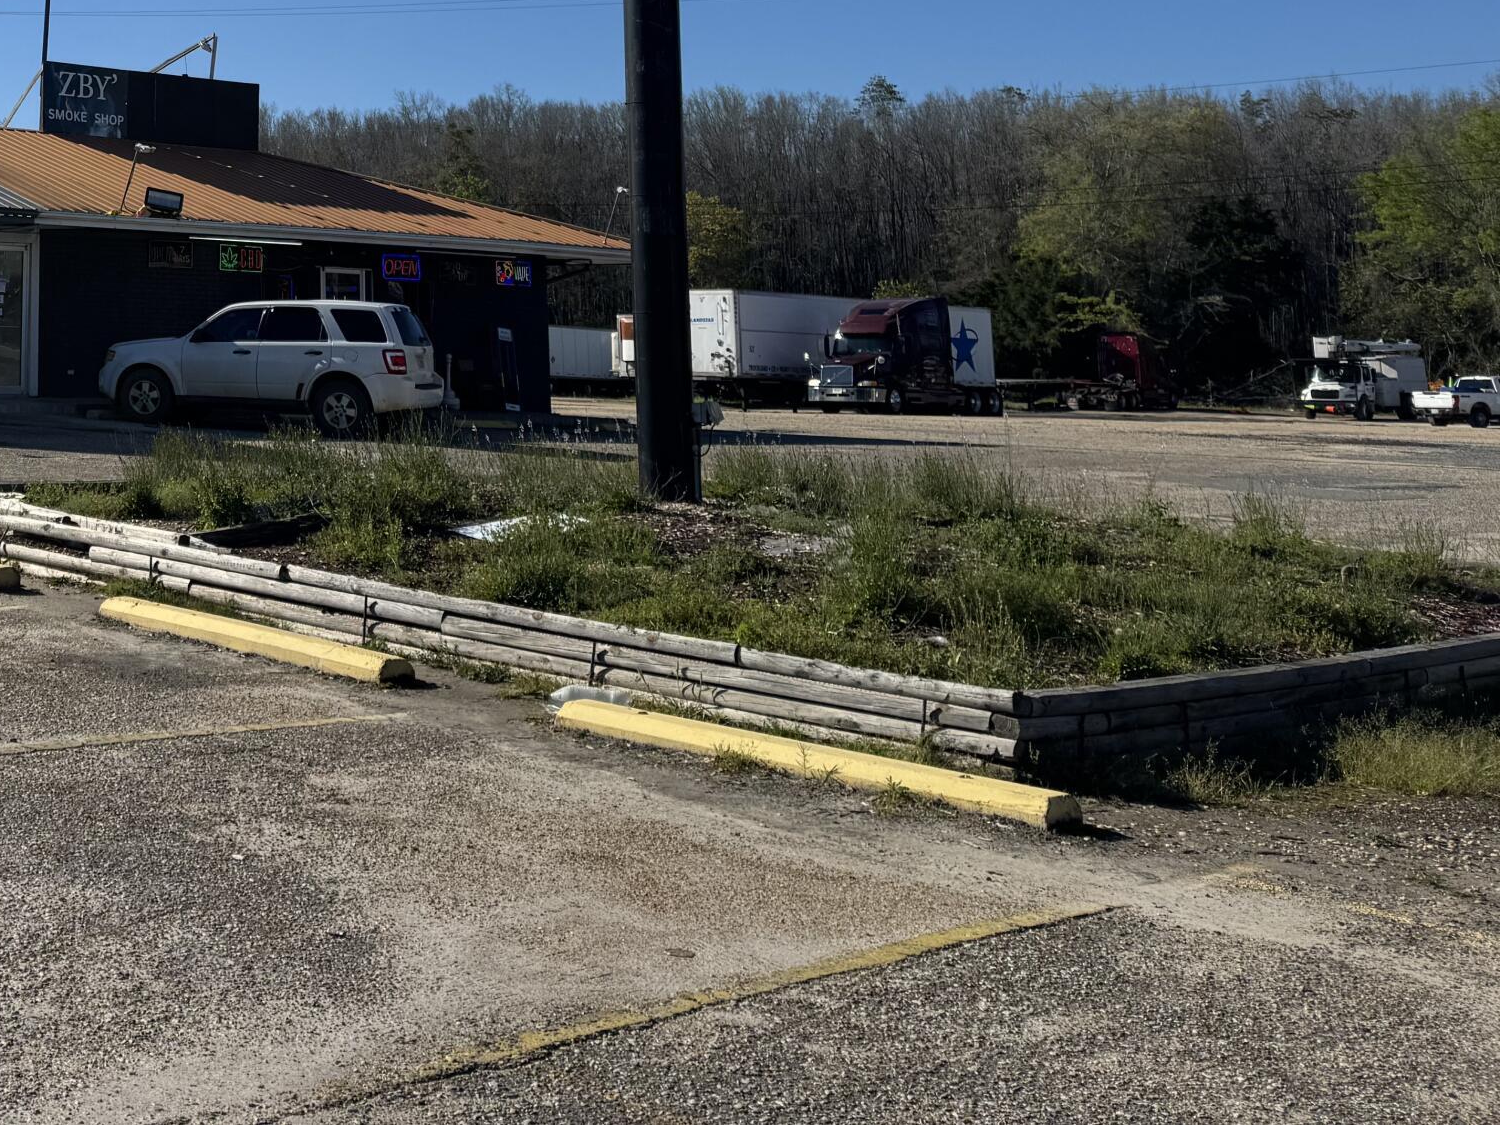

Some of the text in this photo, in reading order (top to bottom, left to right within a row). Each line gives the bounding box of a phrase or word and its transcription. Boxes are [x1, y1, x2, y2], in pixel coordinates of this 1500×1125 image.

[48, 108, 124, 126] SMOKE SHOP
[384, 259, 418, 276] OPEN
